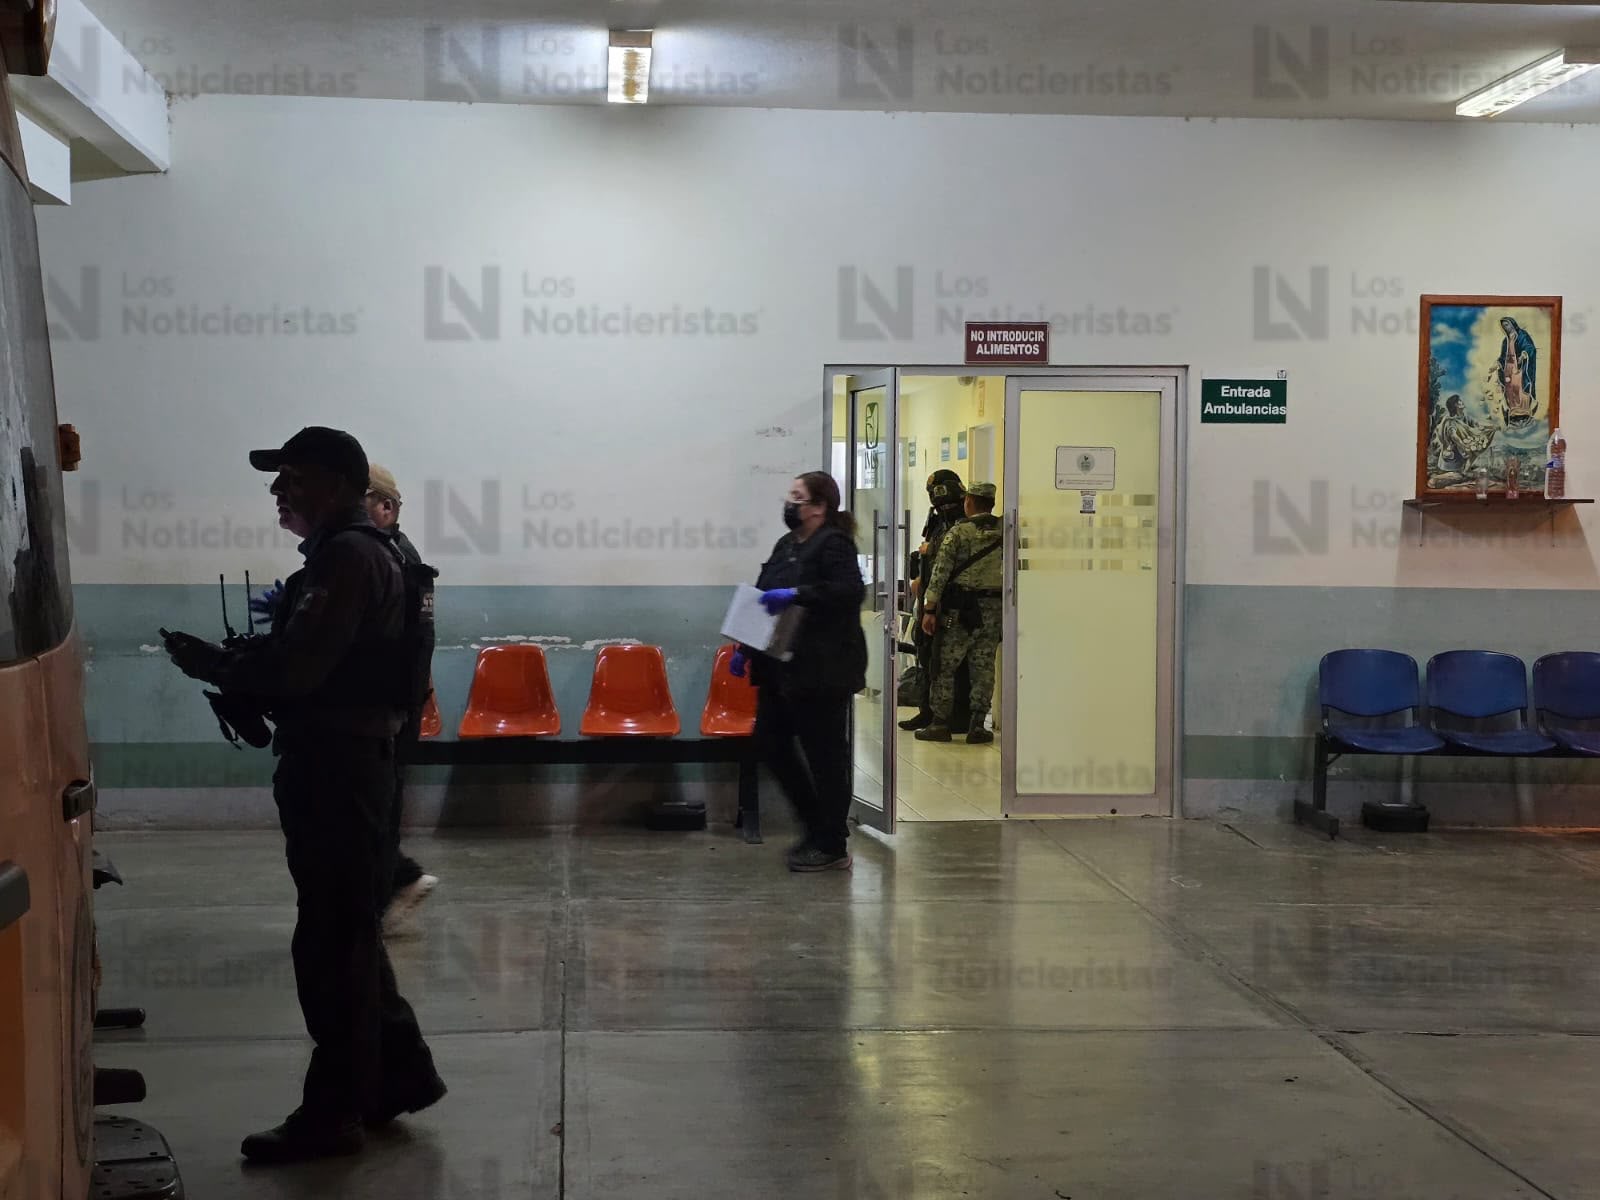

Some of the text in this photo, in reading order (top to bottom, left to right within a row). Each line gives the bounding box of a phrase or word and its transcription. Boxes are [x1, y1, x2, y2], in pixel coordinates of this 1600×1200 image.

[970, 330, 1045, 342] NO INTRODUCIR
[975, 343, 1040, 355] ALIMENTOS
[1221, 385, 1271, 398] Entrada
[1203, 402, 1287, 415] Ambulancias
